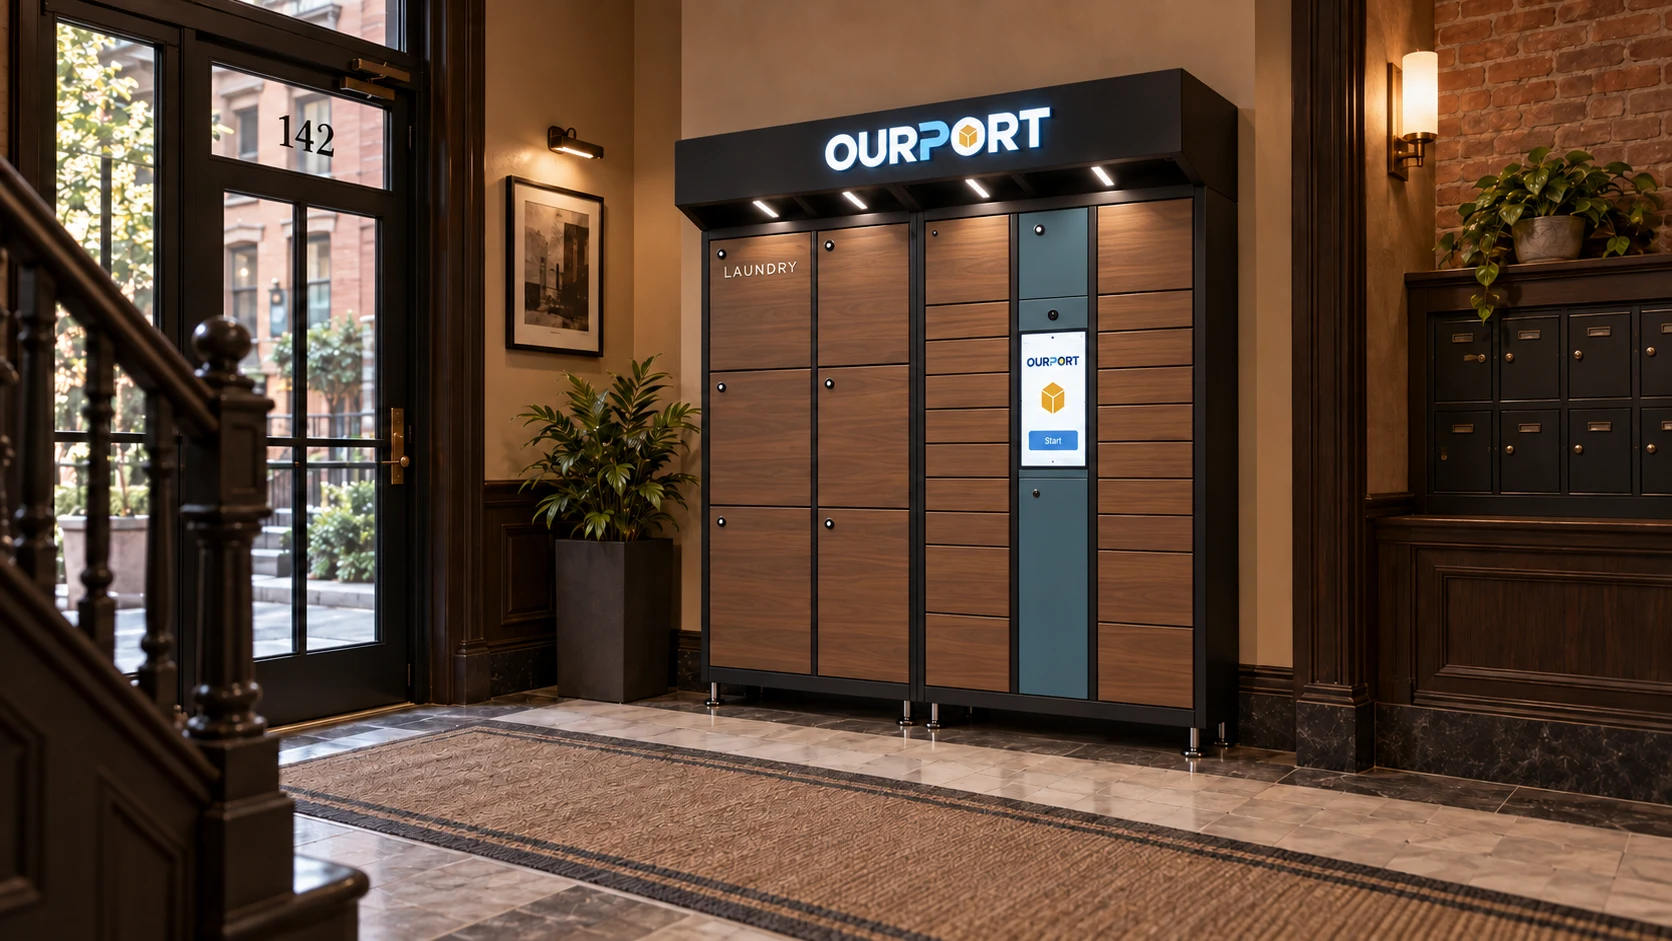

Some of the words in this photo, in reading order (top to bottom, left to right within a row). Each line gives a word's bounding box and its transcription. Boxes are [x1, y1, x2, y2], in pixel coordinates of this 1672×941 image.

[279, 115, 334, 157] 142
[825, 107, 1050, 171] OURPORT
[724, 261, 797, 278] LAUNDRY
[1026, 356, 1080, 367] OURPORT
[1044, 436, 1062, 445] Start
